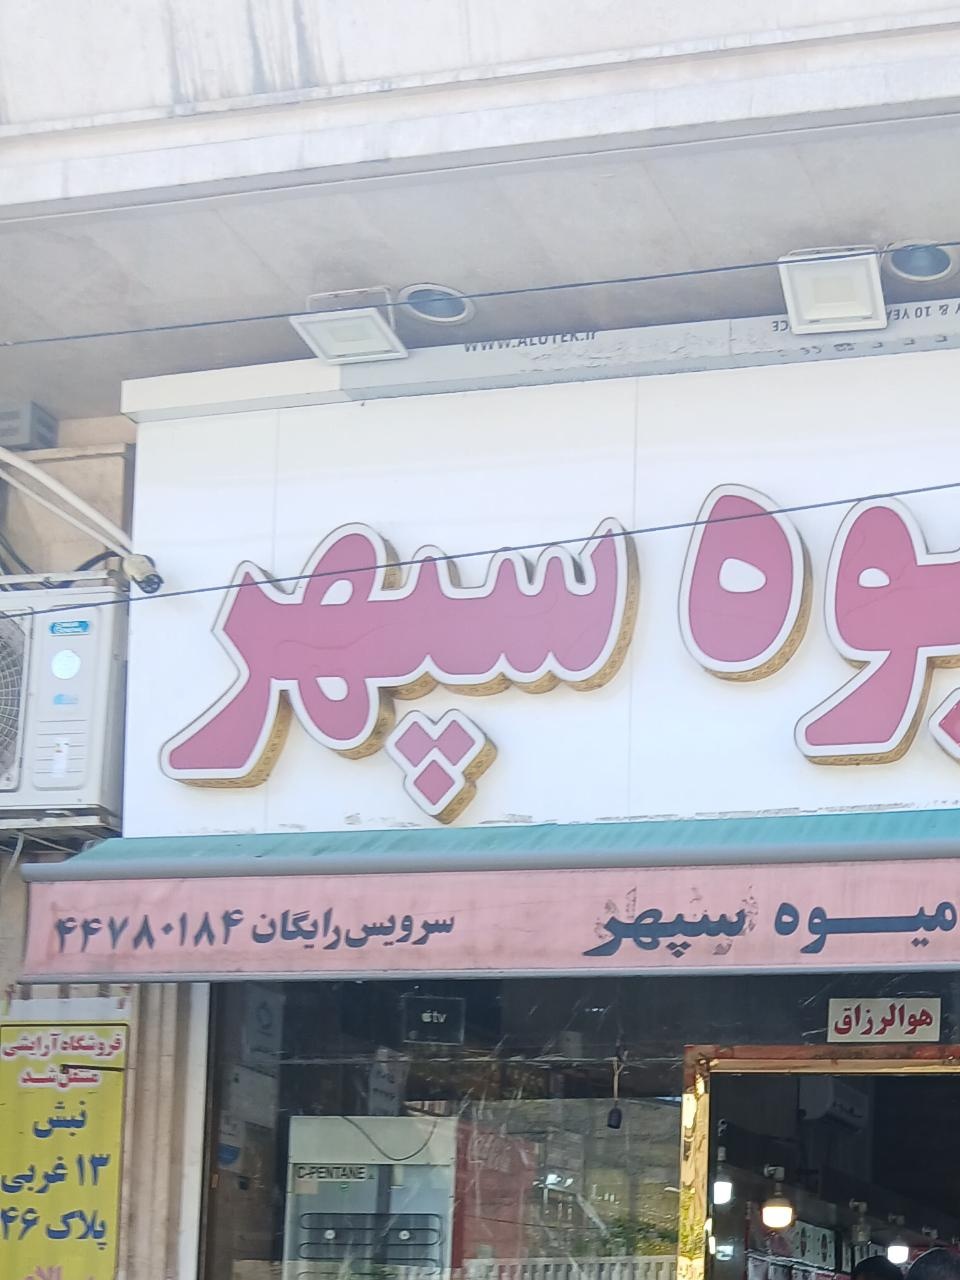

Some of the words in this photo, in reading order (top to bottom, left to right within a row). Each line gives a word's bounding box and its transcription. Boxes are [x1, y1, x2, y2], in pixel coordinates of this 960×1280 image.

[914, 305, 931, 319] 10
[160, 516, 638, 822] سپهر
[54, 908, 246, 954] ۴۴۷۸۰۱۸۴
[251, 907, 340, 950] رایگان
[344, 910, 455, 949] سرویس
[582, 902, 750, 958] سپهر
[773, 898, 958, 955] میوه
[61, 1033, 123, 1057] فروشگاه
[33, 1101, 87, 1138] نبش
[1, 1155, 68, 1194] غربی
[77, 1153, 112, 1186] ۱۳
[45, 1209, 108, 1250] پلاک
